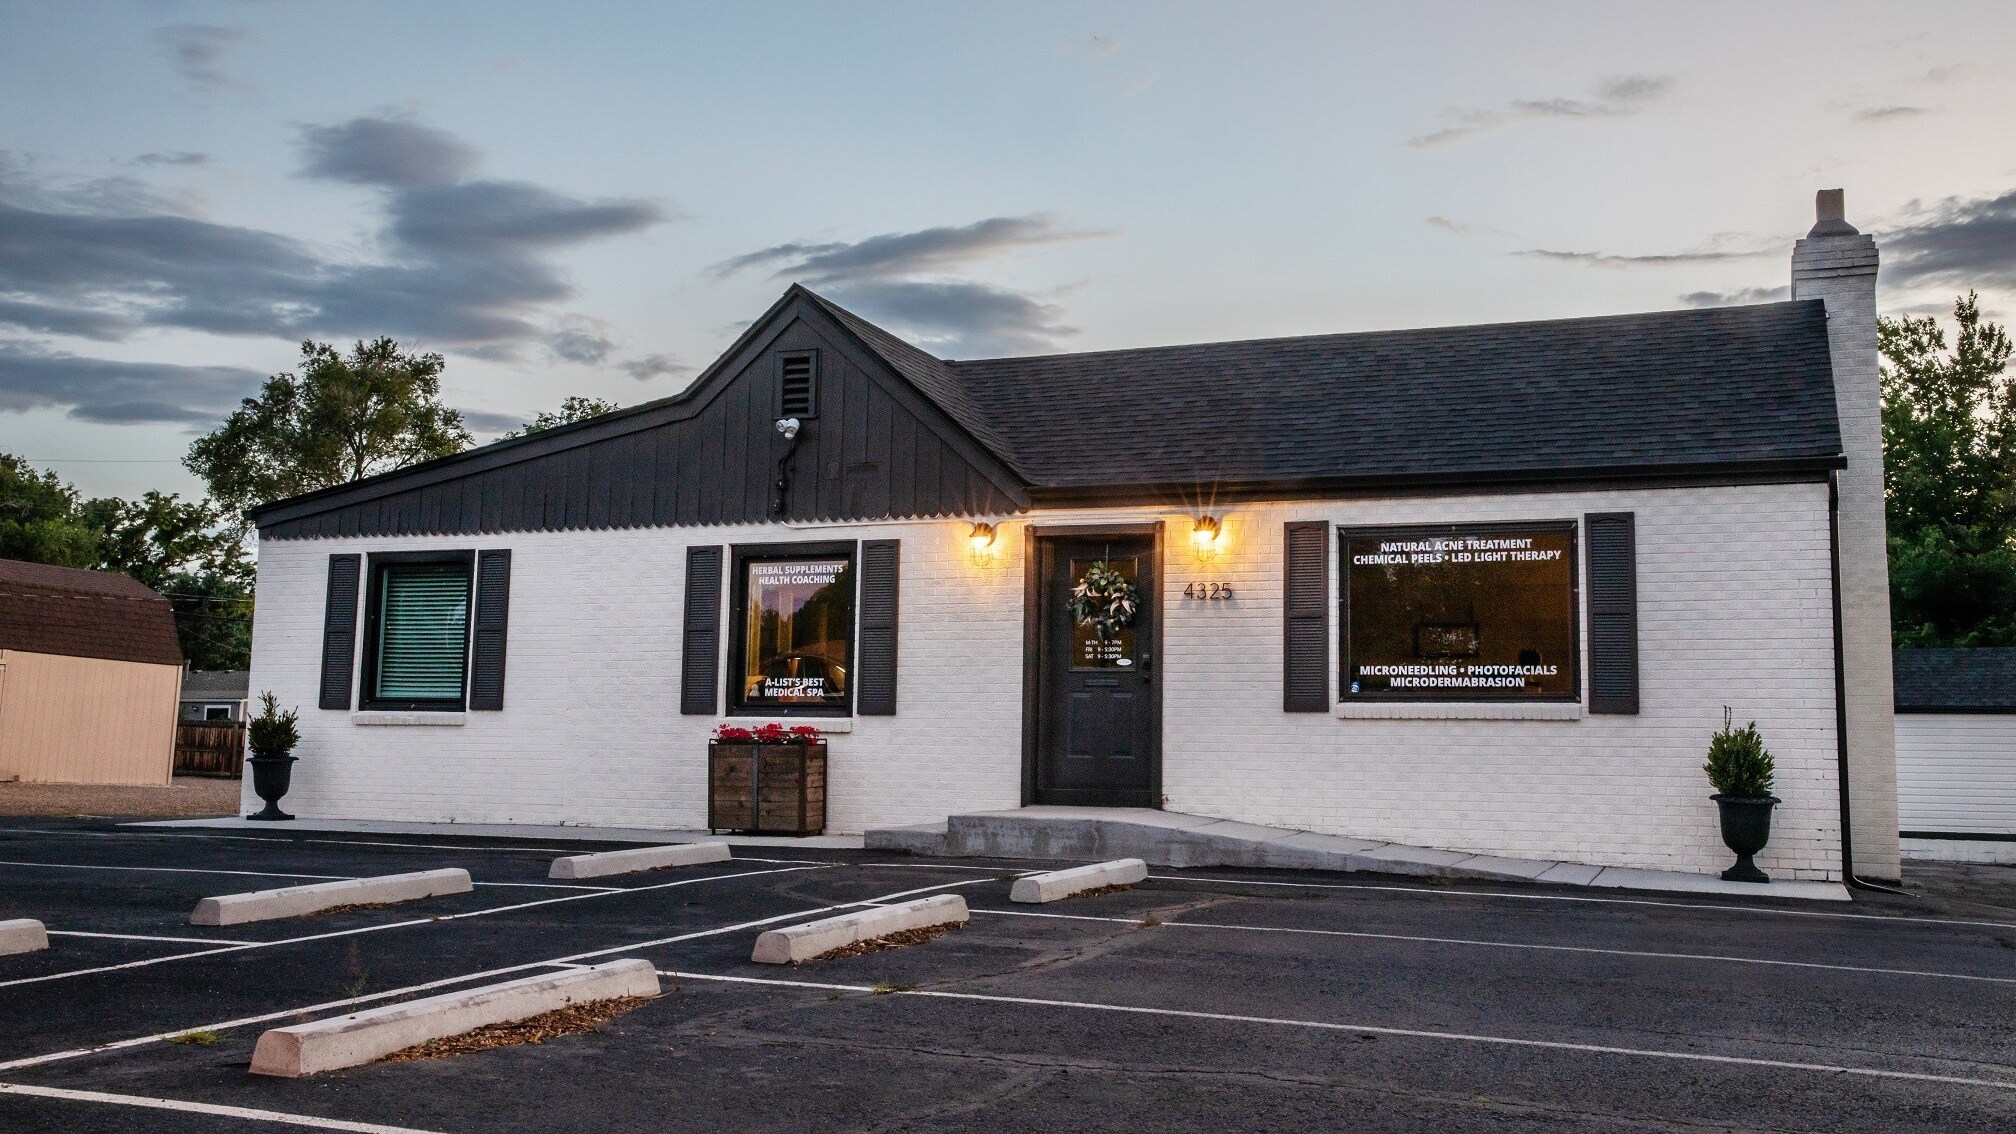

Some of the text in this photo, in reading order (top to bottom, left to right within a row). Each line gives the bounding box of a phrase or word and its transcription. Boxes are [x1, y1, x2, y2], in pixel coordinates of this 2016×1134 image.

[1380, 538, 1532, 552] NATURAL ACNE TREATMENT
[1353, 549, 1562, 565] CHEMICAL PEELS LED LIGHT THERAPY
[752, 564, 843, 575] HERBAL SUPPLEMENTS
[758, 575, 836, 585] HEALTH COACHING
[1183, 583, 1232, 599] 4325
[1359, 665, 1557, 675] MICRONEEDLING PHOTOFACIALS
[765, 678, 824, 687] A-LIST'S BEST
[1390, 677, 1525, 687] MICRODERMABRASION
[764, 688, 825, 697] MEDICAL SPA
